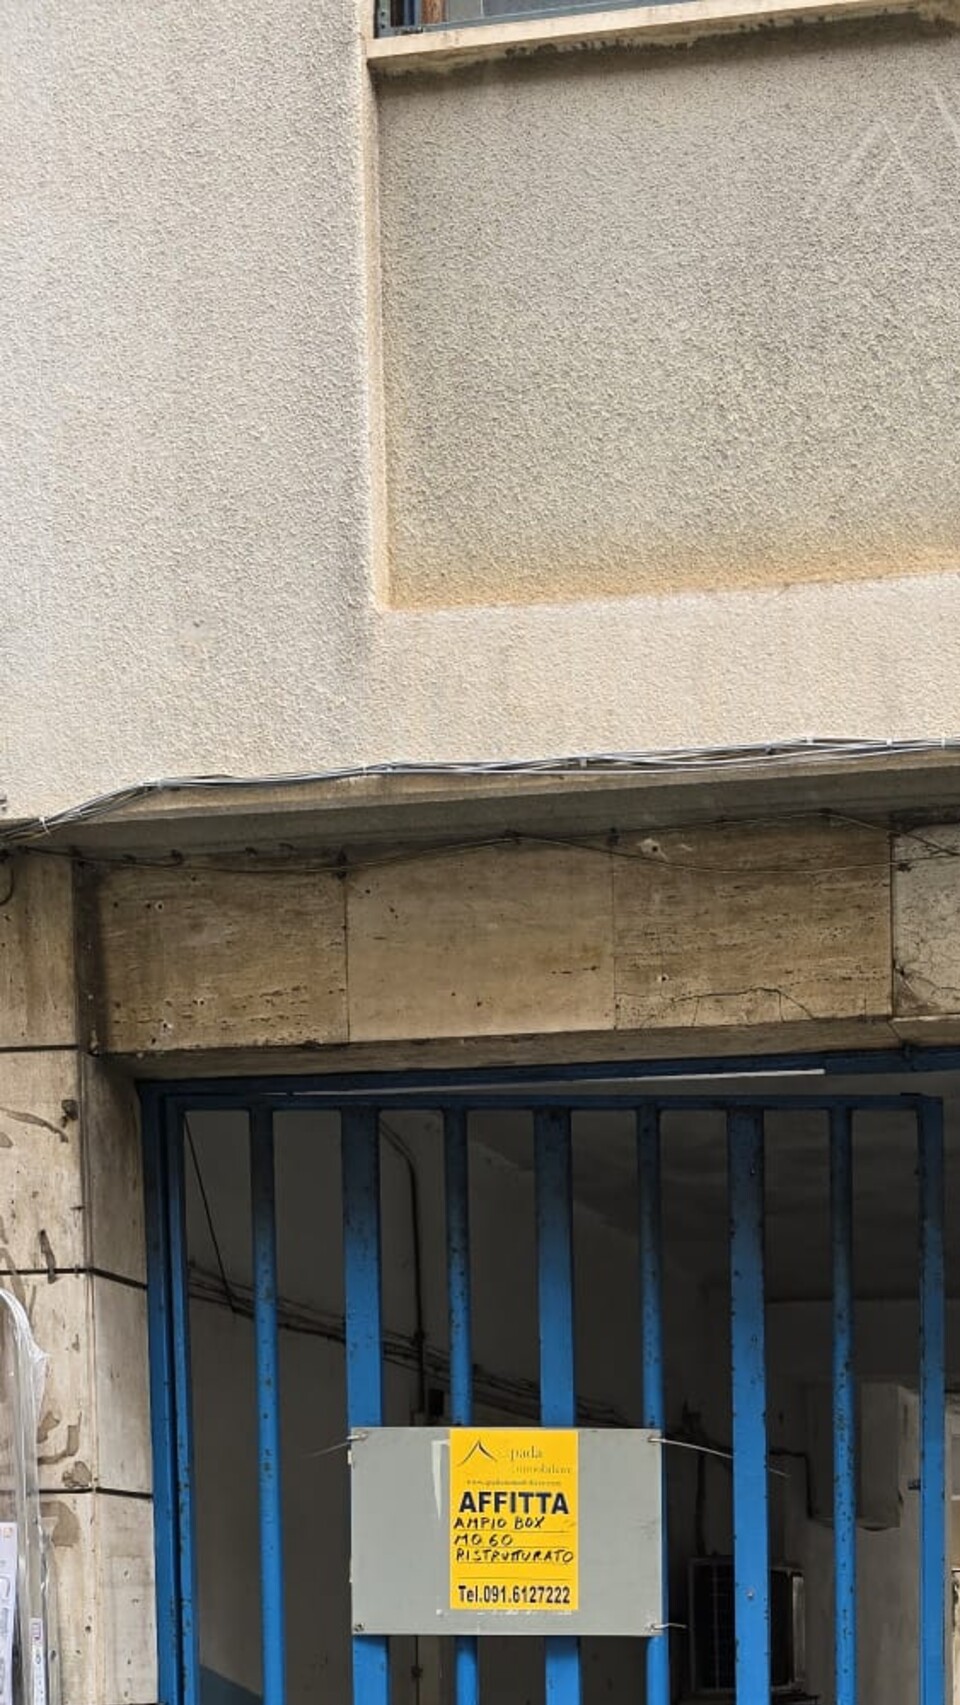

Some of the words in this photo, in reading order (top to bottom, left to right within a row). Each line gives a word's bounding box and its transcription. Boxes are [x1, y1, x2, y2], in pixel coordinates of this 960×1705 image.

[459, 1491, 569, 1514] AFFITTA
[454, 1517, 507, 1529] AMPIO
[515, 1516, 545, 1530] BOX
[458, 1585, 570, 1604] Tel.091.6127222
